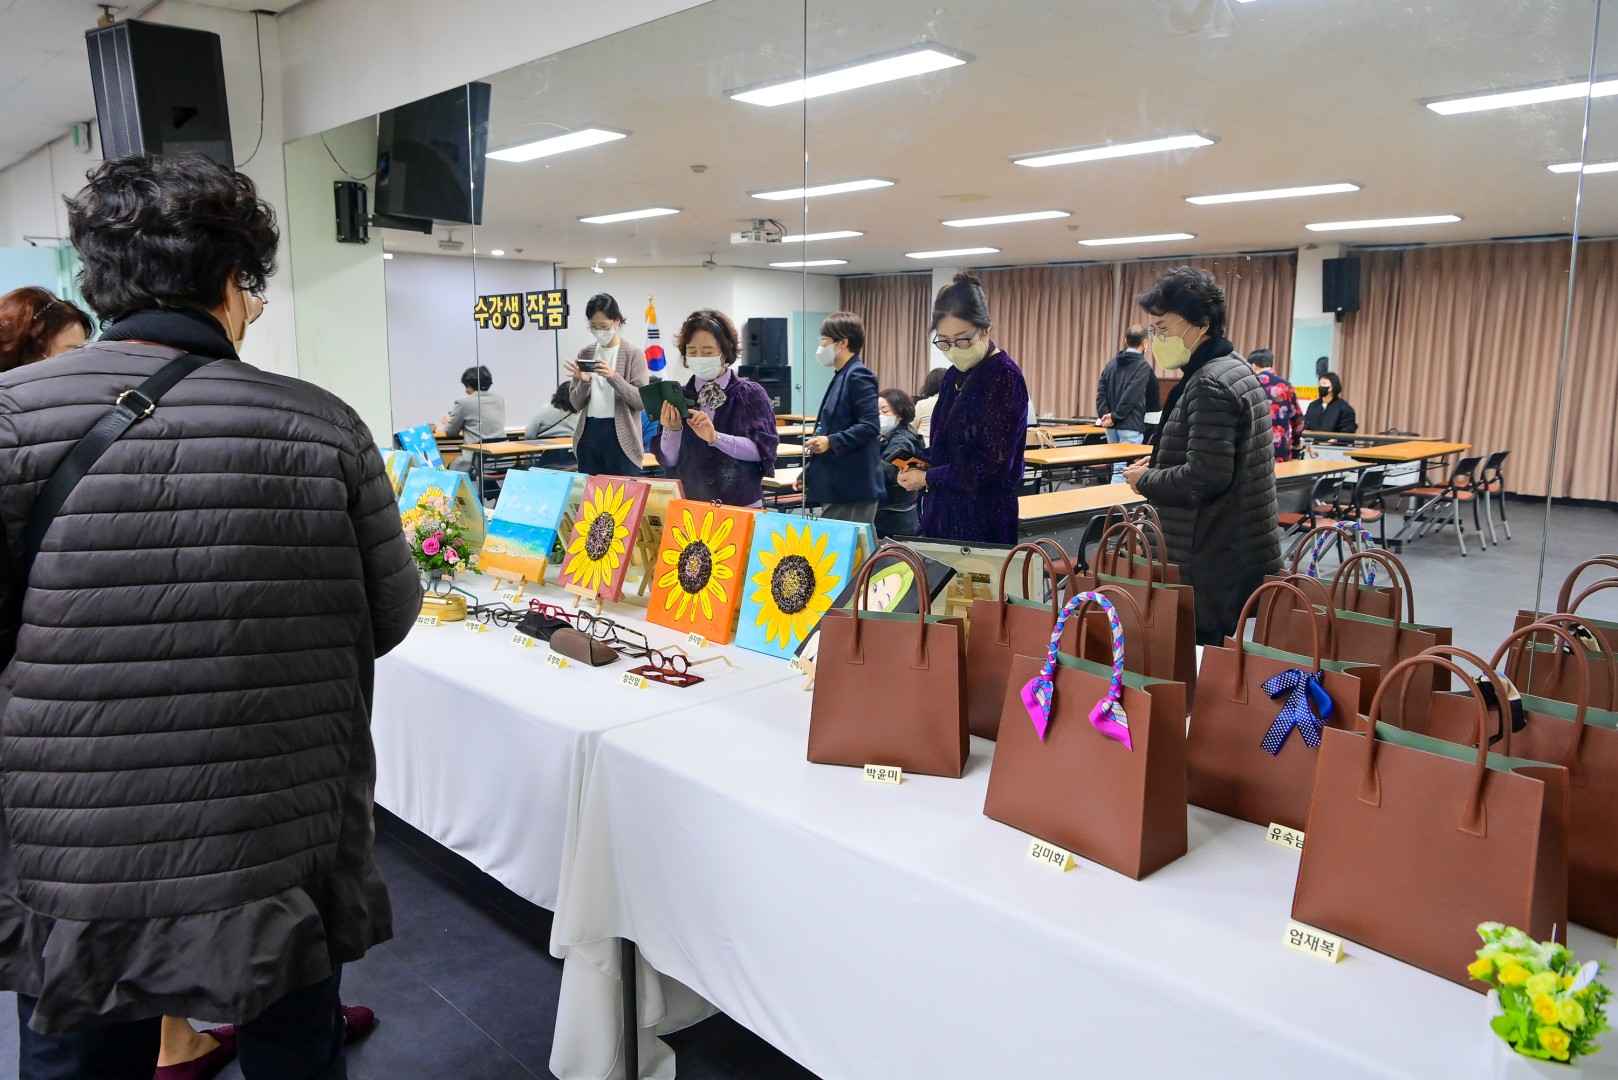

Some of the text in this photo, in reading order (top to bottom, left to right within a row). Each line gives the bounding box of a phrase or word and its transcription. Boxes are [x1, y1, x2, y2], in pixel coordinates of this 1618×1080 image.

[474, 289, 569, 330] 수강생 작품
[866, 768, 898, 781] 박윤미
[1032, 843, 1065, 867] 김미화
[1290, 928, 1335, 957] 엄재복
